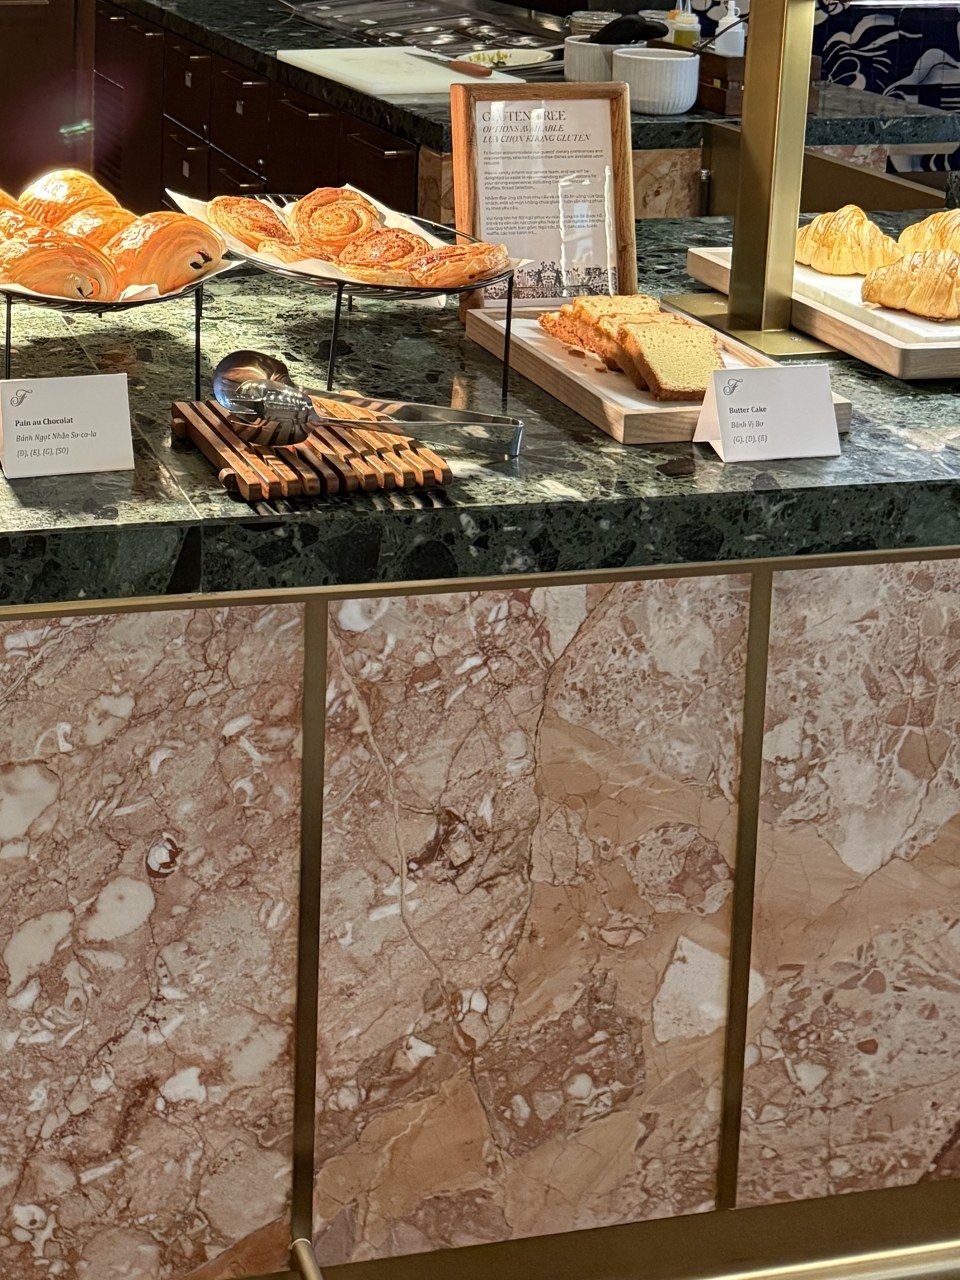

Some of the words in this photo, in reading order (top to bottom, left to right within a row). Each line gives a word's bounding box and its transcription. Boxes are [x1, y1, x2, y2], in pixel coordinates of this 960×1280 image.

[482, 111, 531, 122] GTEN
[43, 417, 73, 425] Chocolat
[35, 434, 50, 442] Ngọt
